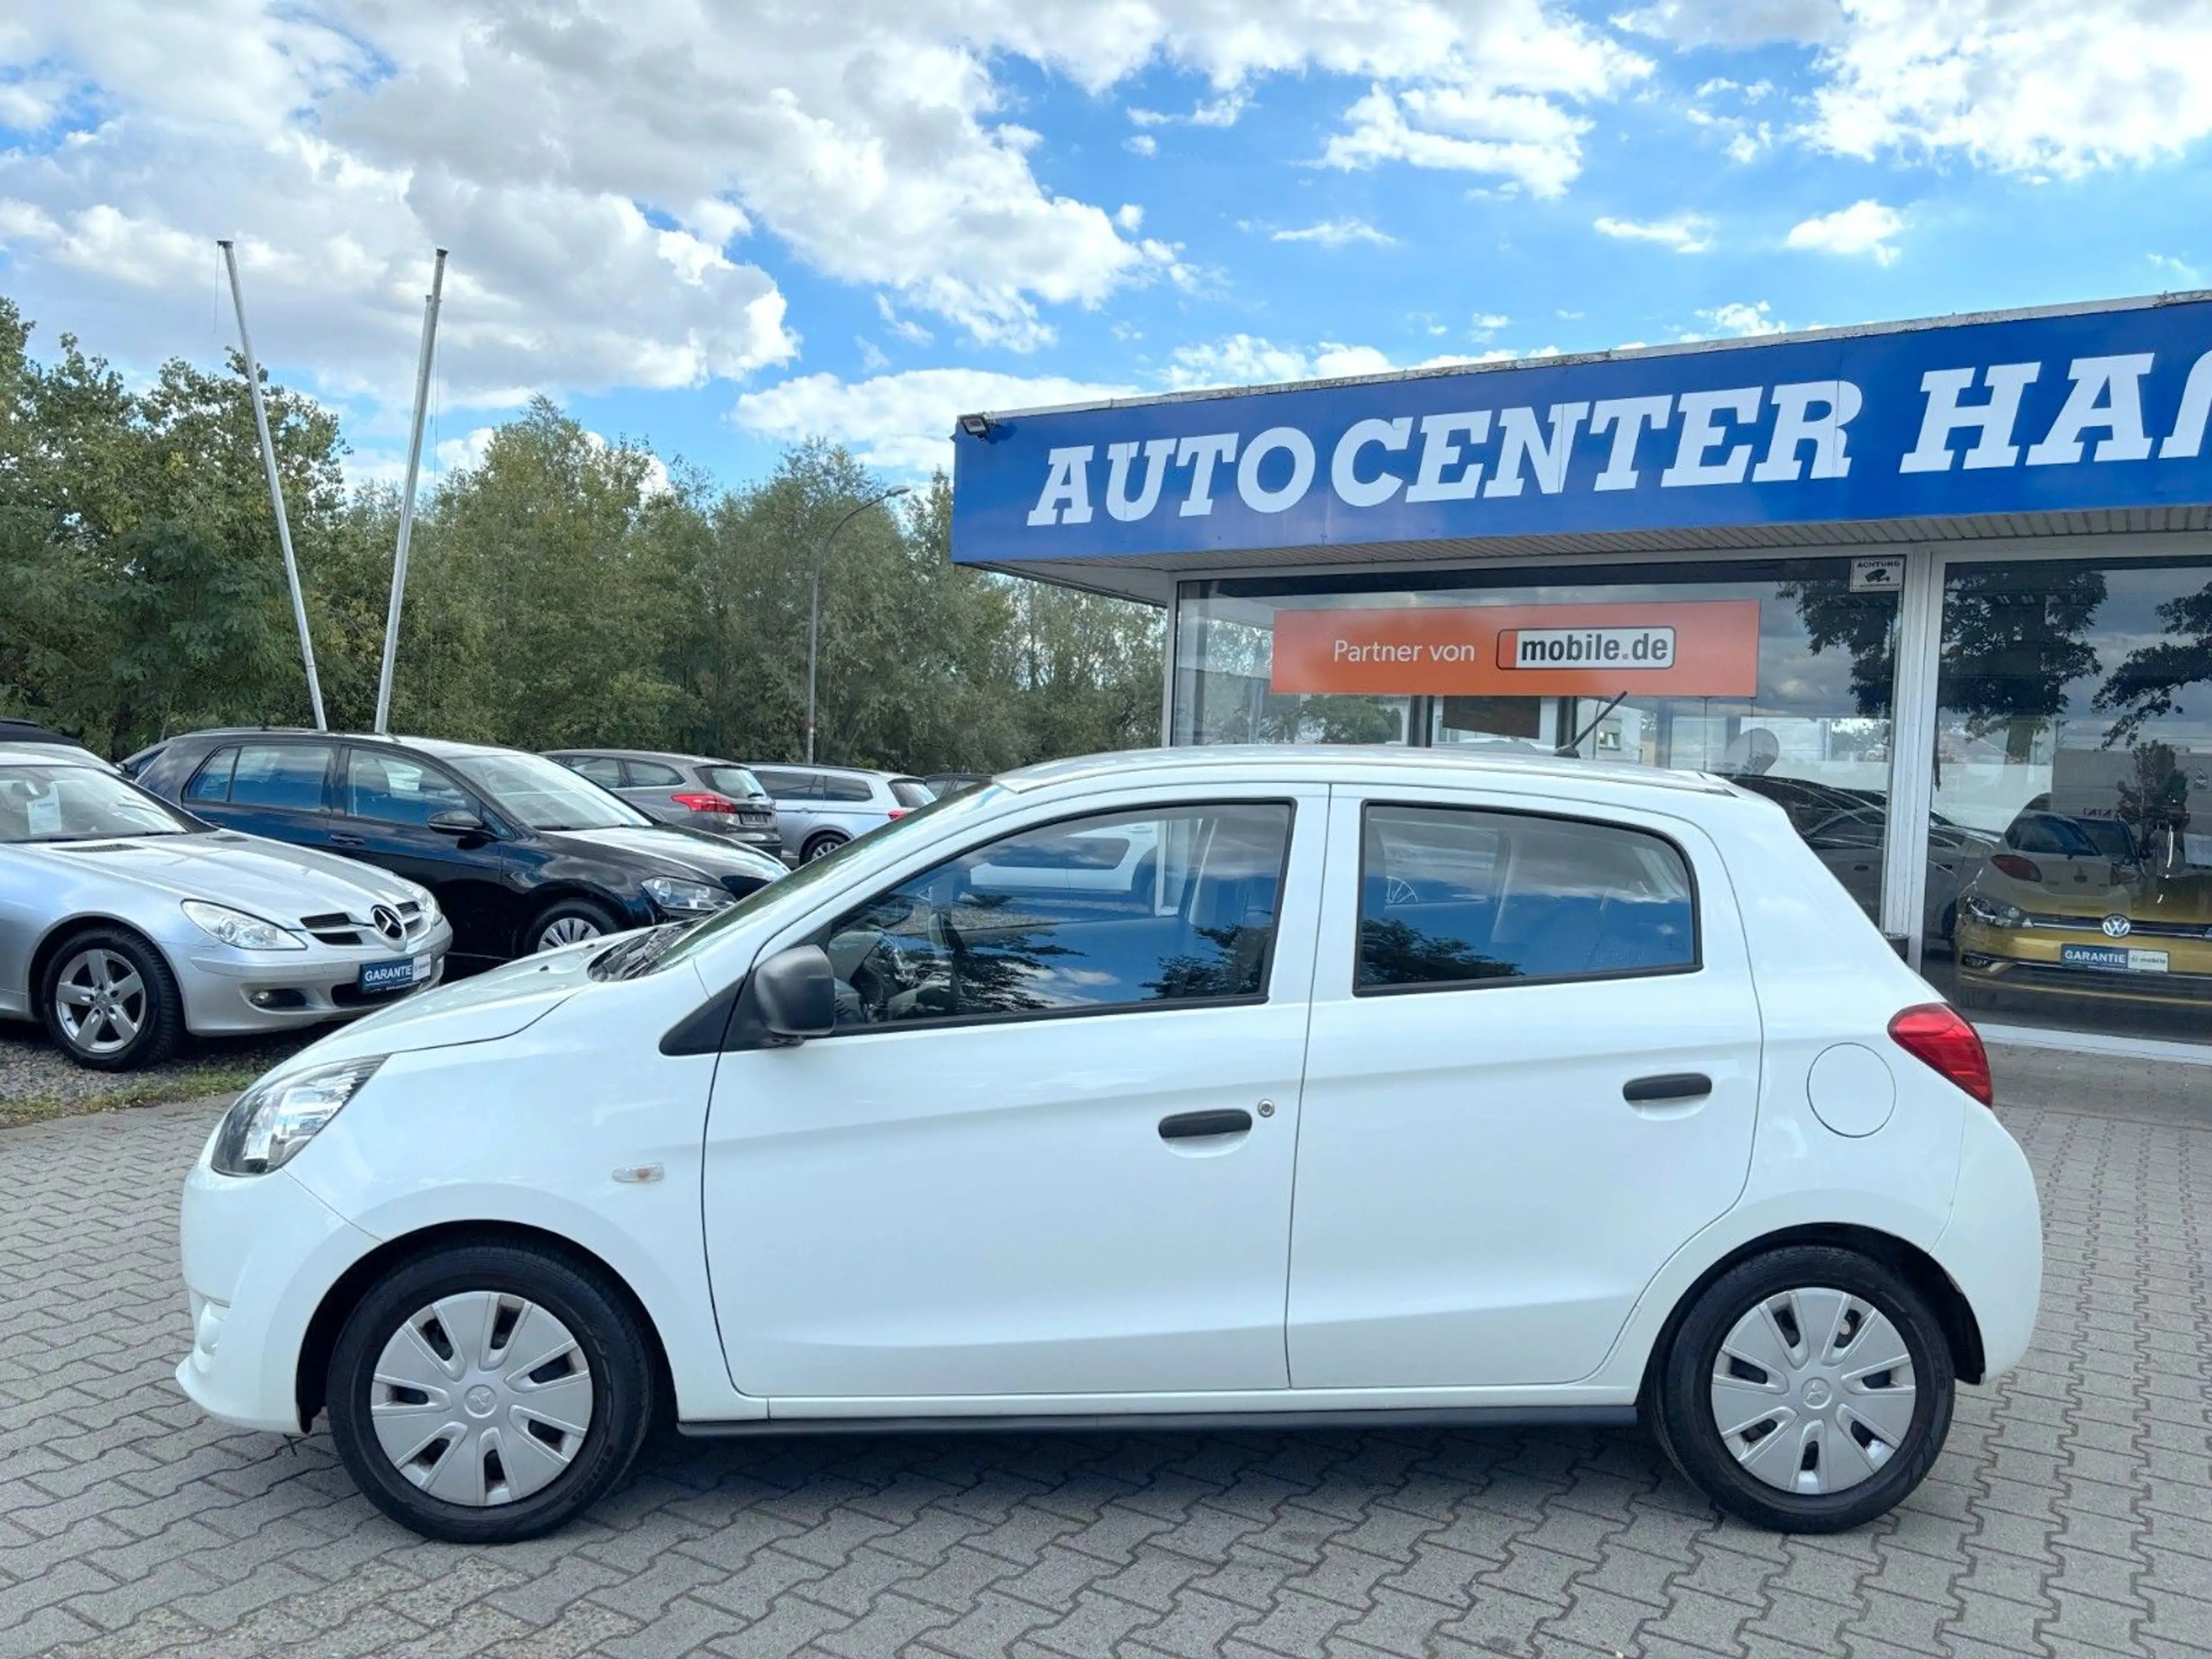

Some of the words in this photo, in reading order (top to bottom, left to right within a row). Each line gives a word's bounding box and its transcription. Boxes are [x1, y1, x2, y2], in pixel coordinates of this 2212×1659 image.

[1857, 559, 1900, 569] ACHTUNG
[1334, 639, 1423, 662] Partner
[1429, 644, 1475, 662] von
[1521, 632, 1668, 661] mobile.de
[2065, 949, 2126, 964] GARANTIE
[365, 965, 412, 982] GARANTIE
